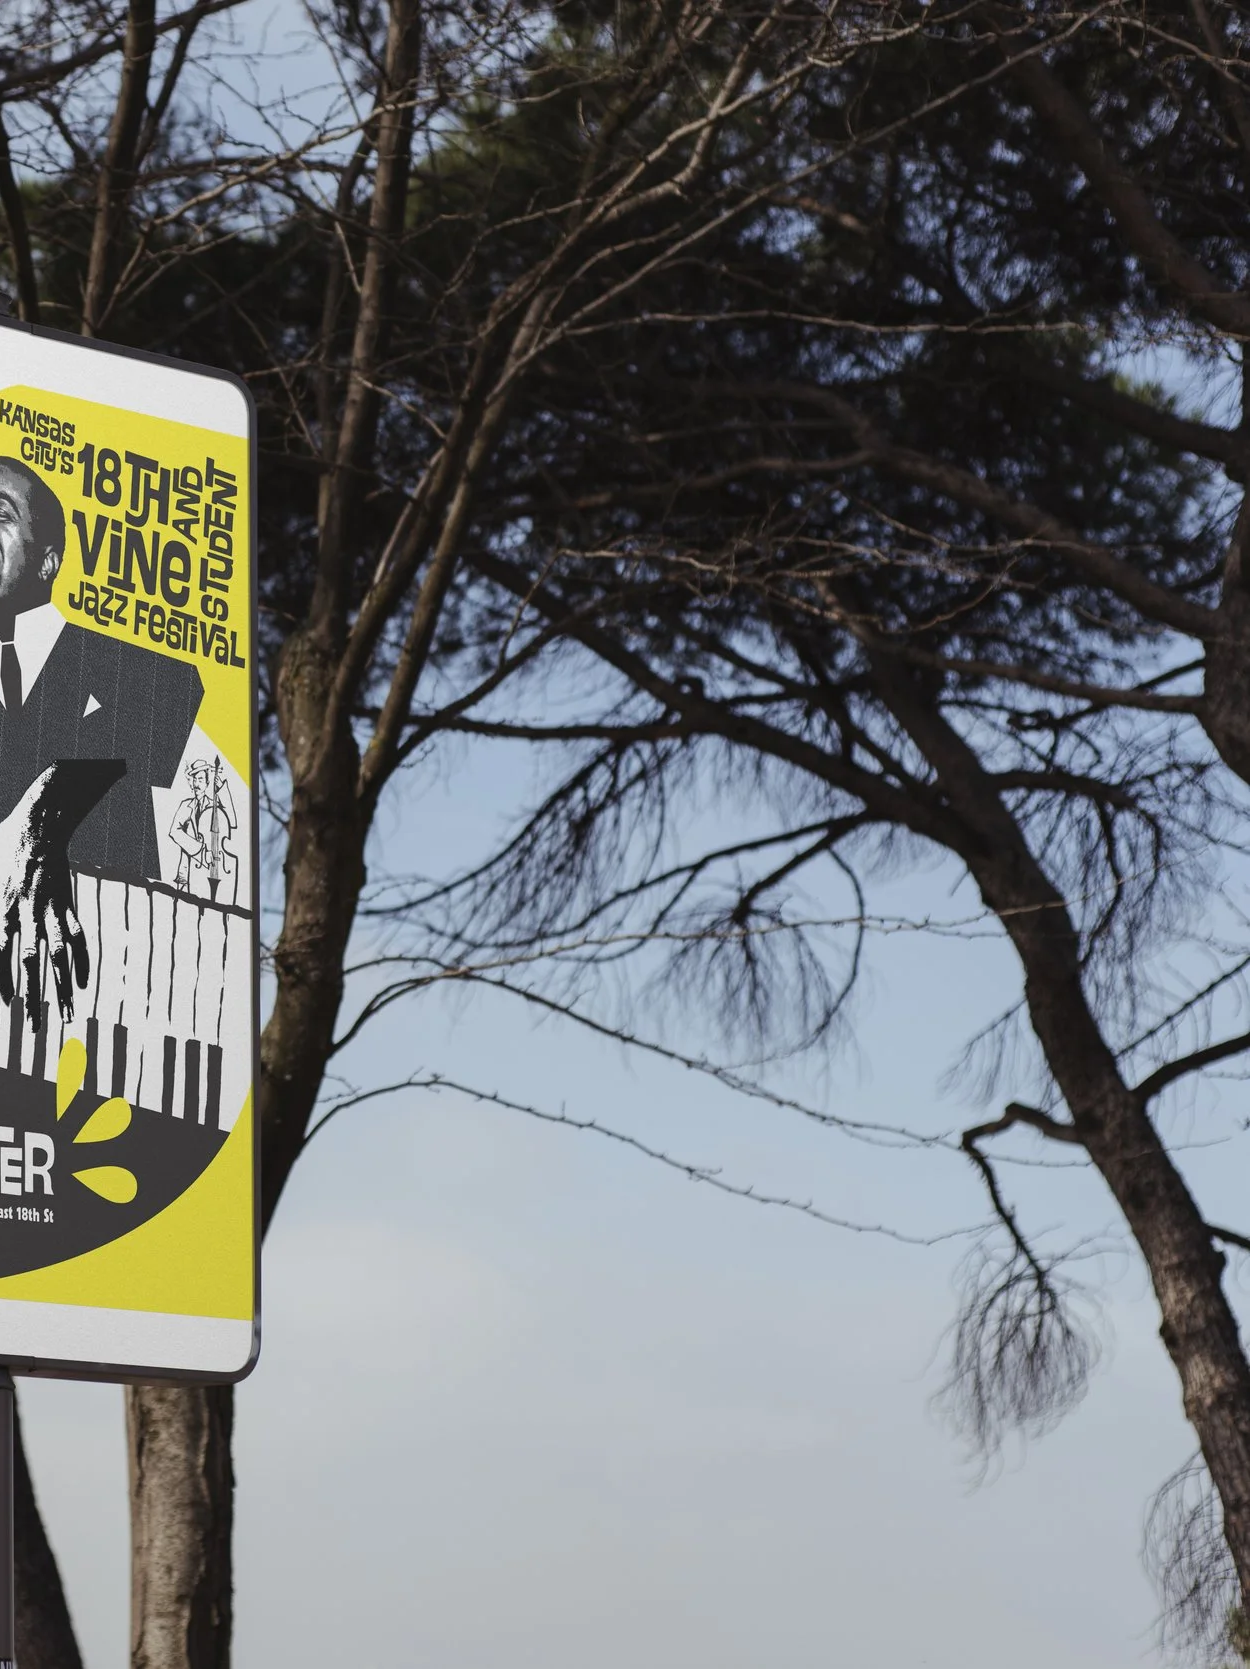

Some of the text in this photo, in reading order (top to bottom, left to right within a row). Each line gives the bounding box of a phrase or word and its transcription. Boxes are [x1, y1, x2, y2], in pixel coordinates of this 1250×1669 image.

[77, 442, 171, 528] 18TH
[171, 464, 203, 545] AND
[198, 456, 238, 622] STUDENT
[17, 1206, 40, 1222] 18th
[43, 1209, 55, 1224] St
